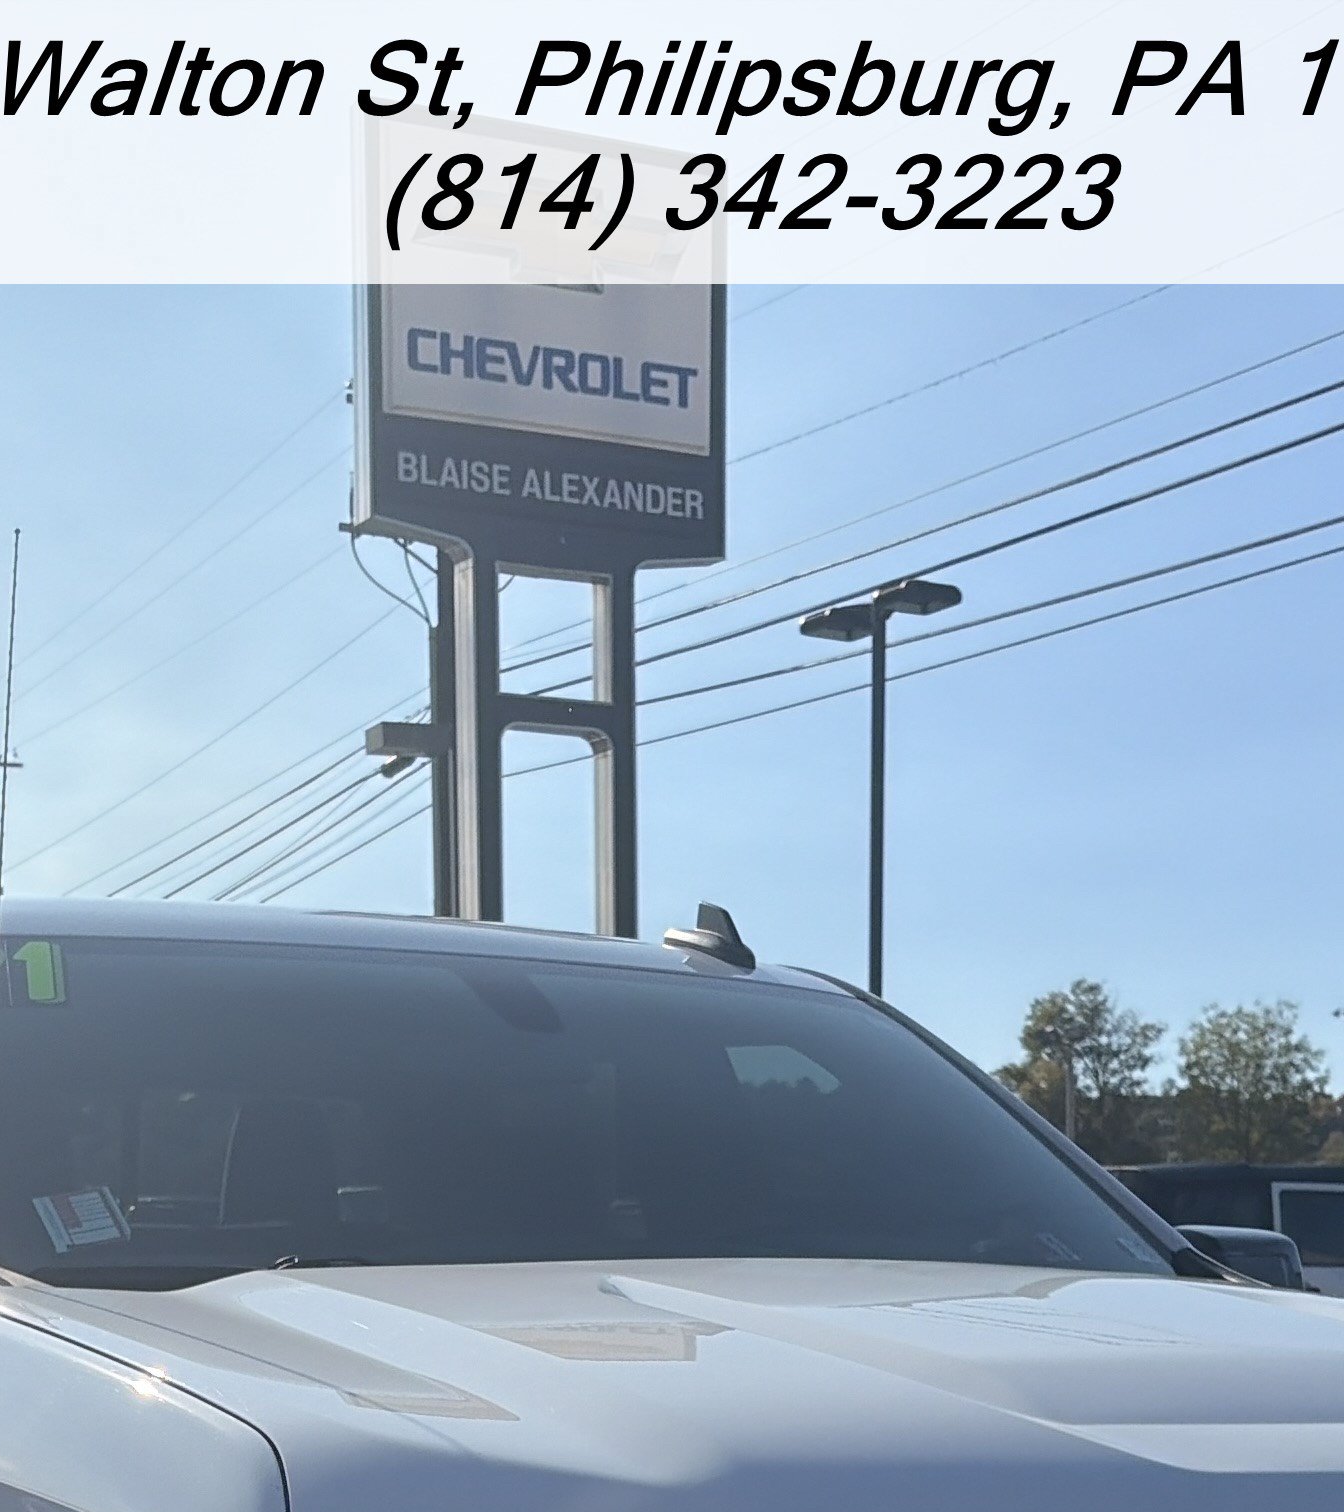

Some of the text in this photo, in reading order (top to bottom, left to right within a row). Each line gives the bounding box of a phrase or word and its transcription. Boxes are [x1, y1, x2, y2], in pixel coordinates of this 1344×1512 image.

[407, 327, 699, 409] CHEVROLET
[397, 451, 705, 520] BLAISE ALEXANDER
